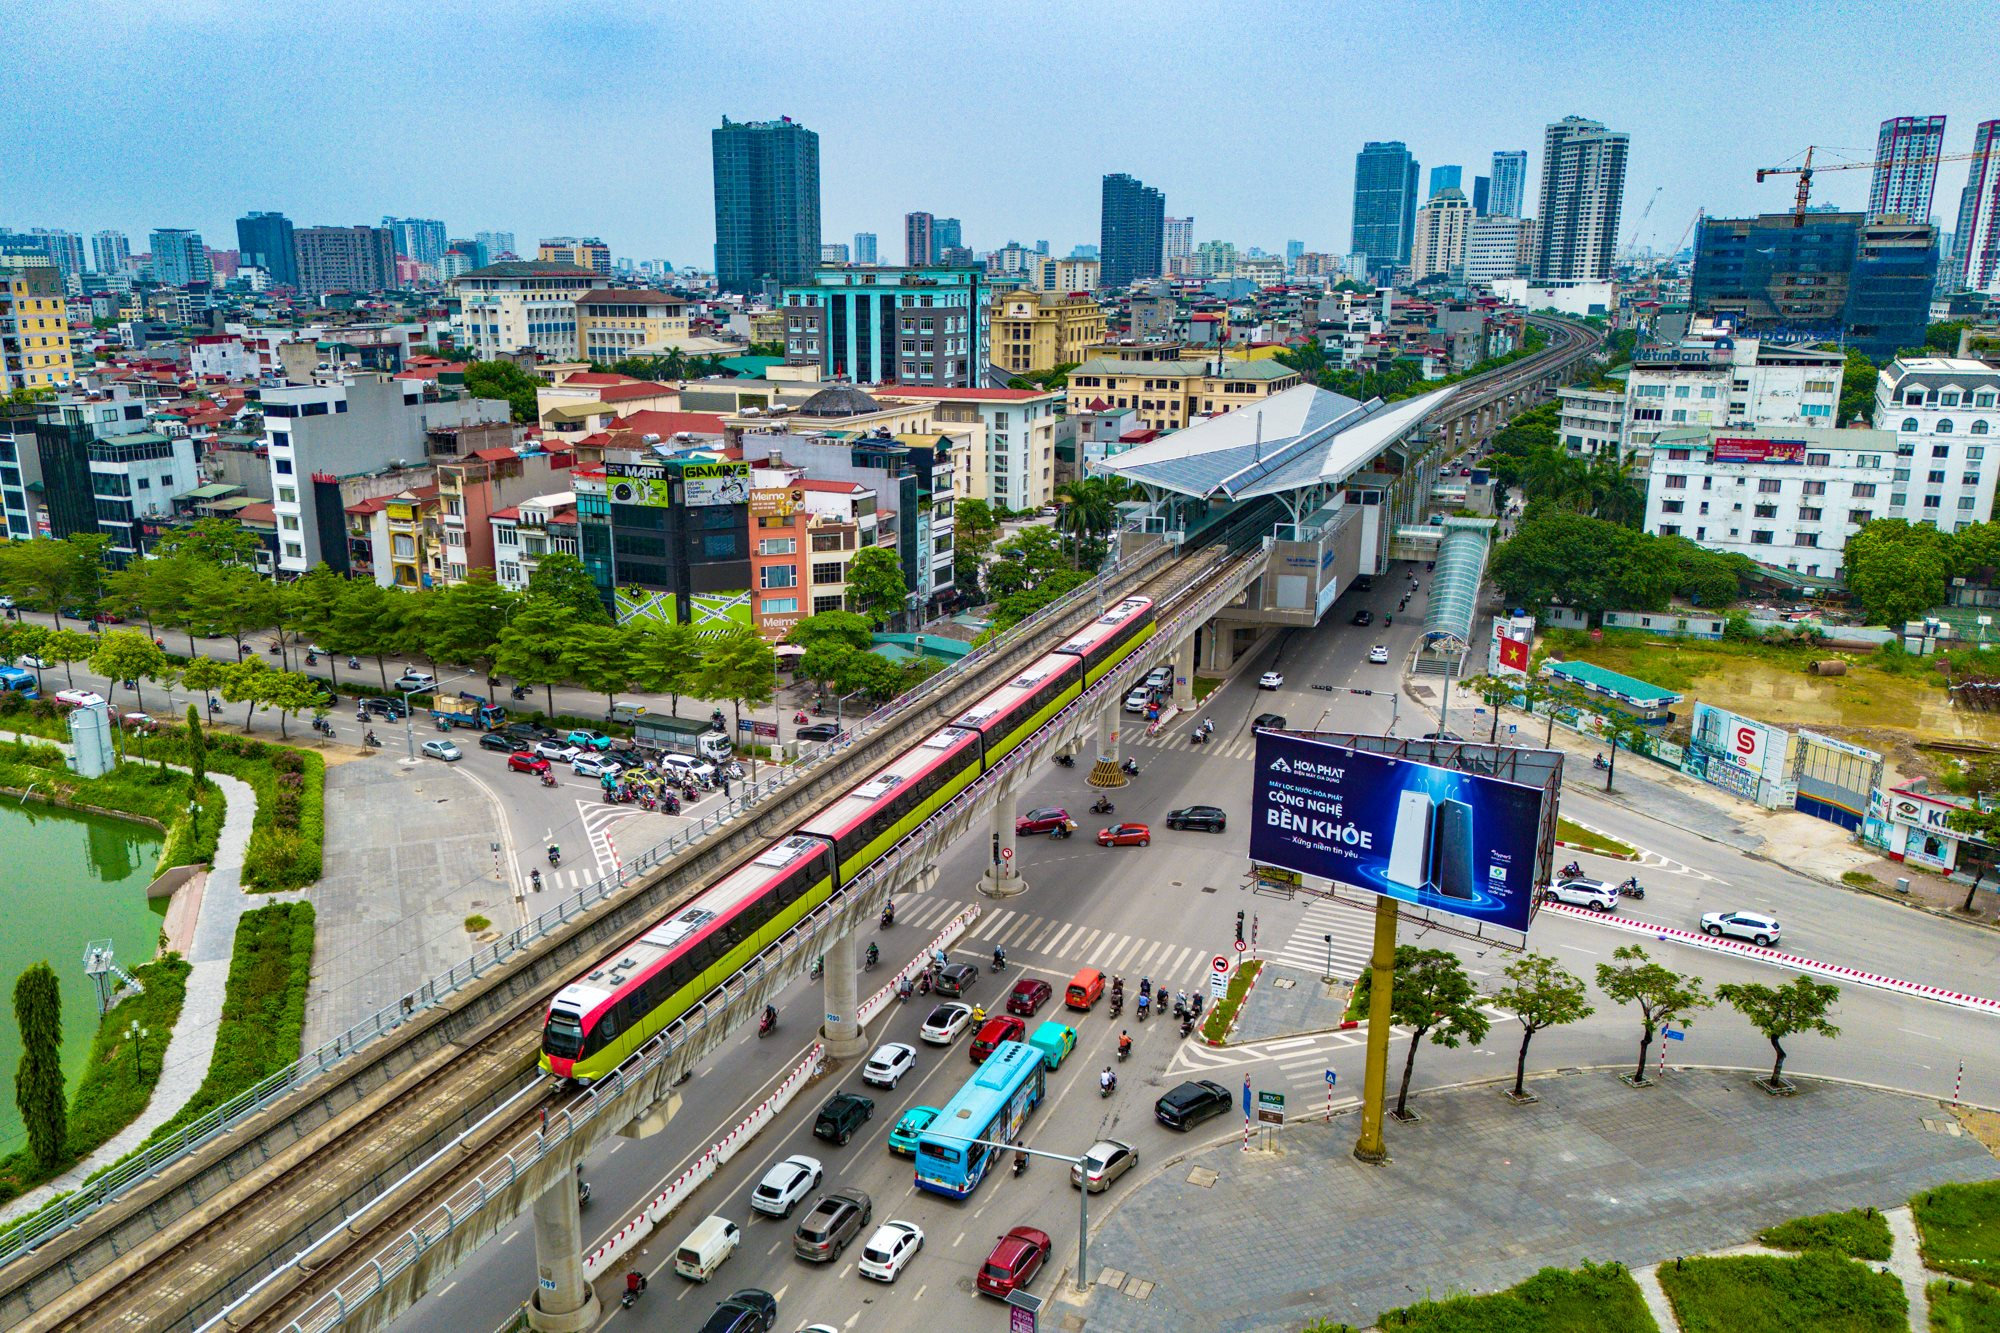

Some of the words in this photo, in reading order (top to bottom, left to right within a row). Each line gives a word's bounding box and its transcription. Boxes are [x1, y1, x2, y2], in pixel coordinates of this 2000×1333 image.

[624, 465, 665, 478] MART
[1268, 790, 1304, 808] CÔNG
[1307, 798, 1342, 818] NGHỆ
[1267, 805, 1308, 834] BỀN
[1312, 822, 1372, 850] KHỎE
[1292, 836, 1312, 849] Xứng
[1333, 846, 1342, 855] tin
[1344, 850, 1358, 859] yêu
[1013, 1310, 1033, 1322] AEON
